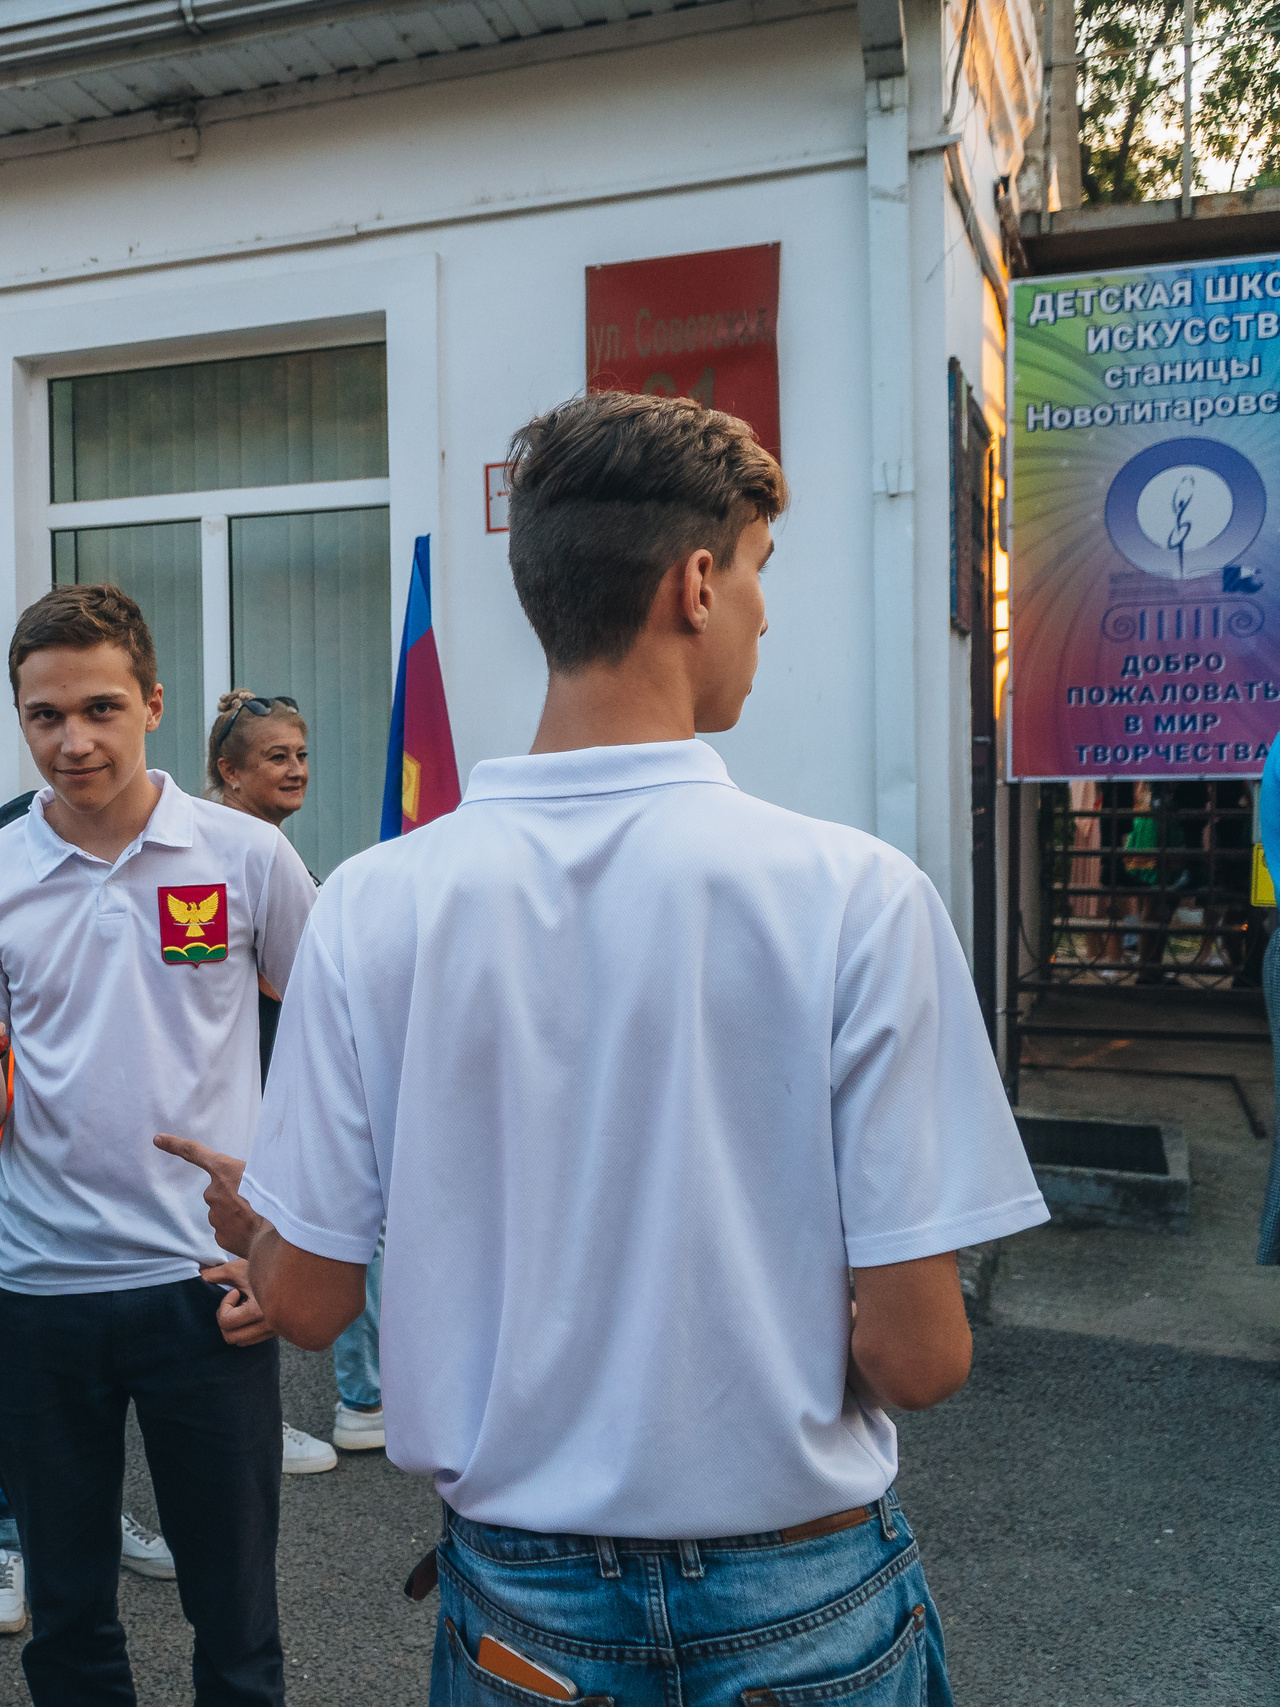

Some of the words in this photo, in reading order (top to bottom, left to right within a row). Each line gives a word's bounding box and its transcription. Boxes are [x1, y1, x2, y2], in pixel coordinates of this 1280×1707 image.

[1029, 279, 1193, 327] ДЕТСКАЯ
[591, 322, 627, 376] ул.
[1087, 311, 1279, 355] ИСКУССТВ
[1104, 355, 1261, 389] станицы
[1026, 391, 1279, 432] Новотитаровс
[1121, 652, 1226, 680] ДОБРО
[1067, 681, 1280, 708] ПОЖАЛОВАТЬ
[1124, 714, 1143, 736] В
[1153, 712, 1221, 735] МИР
[1074, 741, 1270, 766] ТВОРЧЕСТВА
